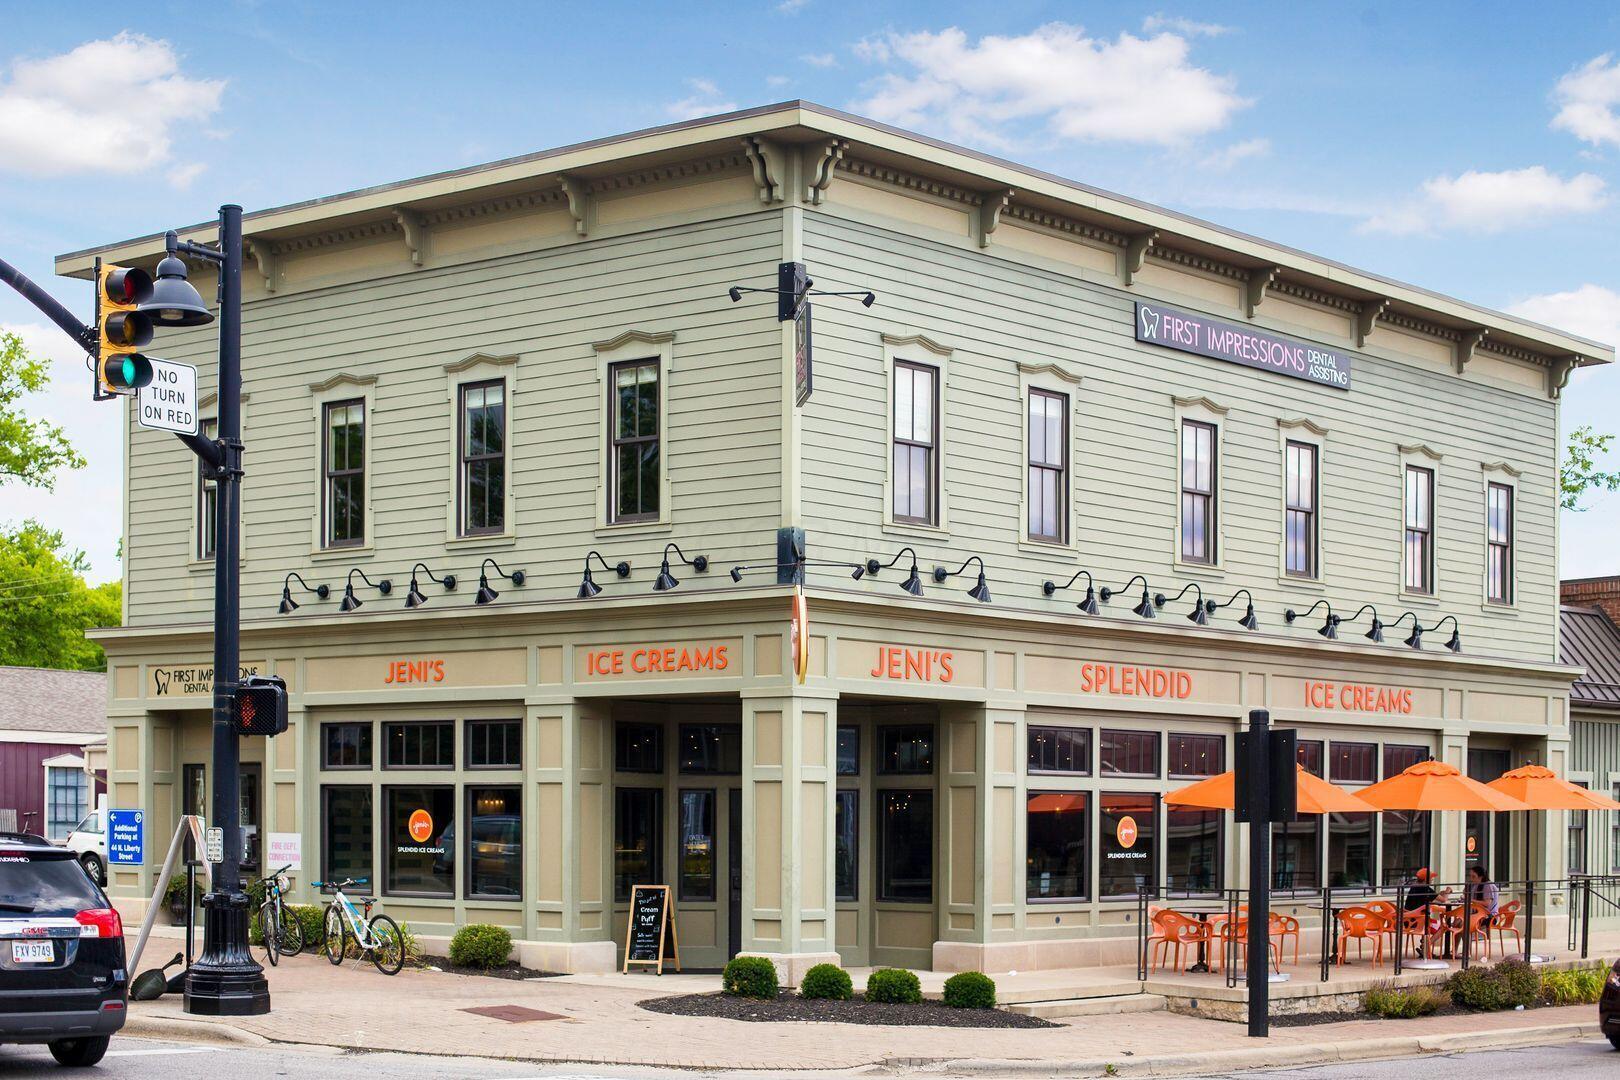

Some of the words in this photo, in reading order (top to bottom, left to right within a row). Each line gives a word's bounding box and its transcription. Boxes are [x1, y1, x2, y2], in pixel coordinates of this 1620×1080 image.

[1163, 316, 1200, 347] FIRST
[1207, 326, 1305, 372] IMPRESSIONS
[1307, 349, 1337, 369] DENTAL
[158, 369, 177, 384] NO
[1308, 364, 1348, 385] ASSISTING
[152, 386, 185, 404] TURN
[144, 405, 162, 420] ON
[167, 409, 192, 425] RED
[587, 651, 623, 675] ICE
[630, 646, 729, 673] CREAMS
[871, 646, 953, 683] JENI'S
[173, 669, 195, 682] FIRST
[384, 659, 445, 683] JENI'S
[184, 683, 209, 693] DENTAL
[1081, 663, 1192, 699] SPLENDID
[1305, 681, 1335, 709] ICE
[1340, 685, 1414, 714] CREAMS
[114, 824, 138, 832] Additional
[114, 832, 132, 842] Parking
[124, 844, 140, 854] Liberty
[271, 841, 282, 850] FIRE
[118, 852, 133, 861] Street
[268, 853, 301, 862] CONNECTION
[22, 927, 48, 936] GMC
[31, 945, 51, 956] 9749
